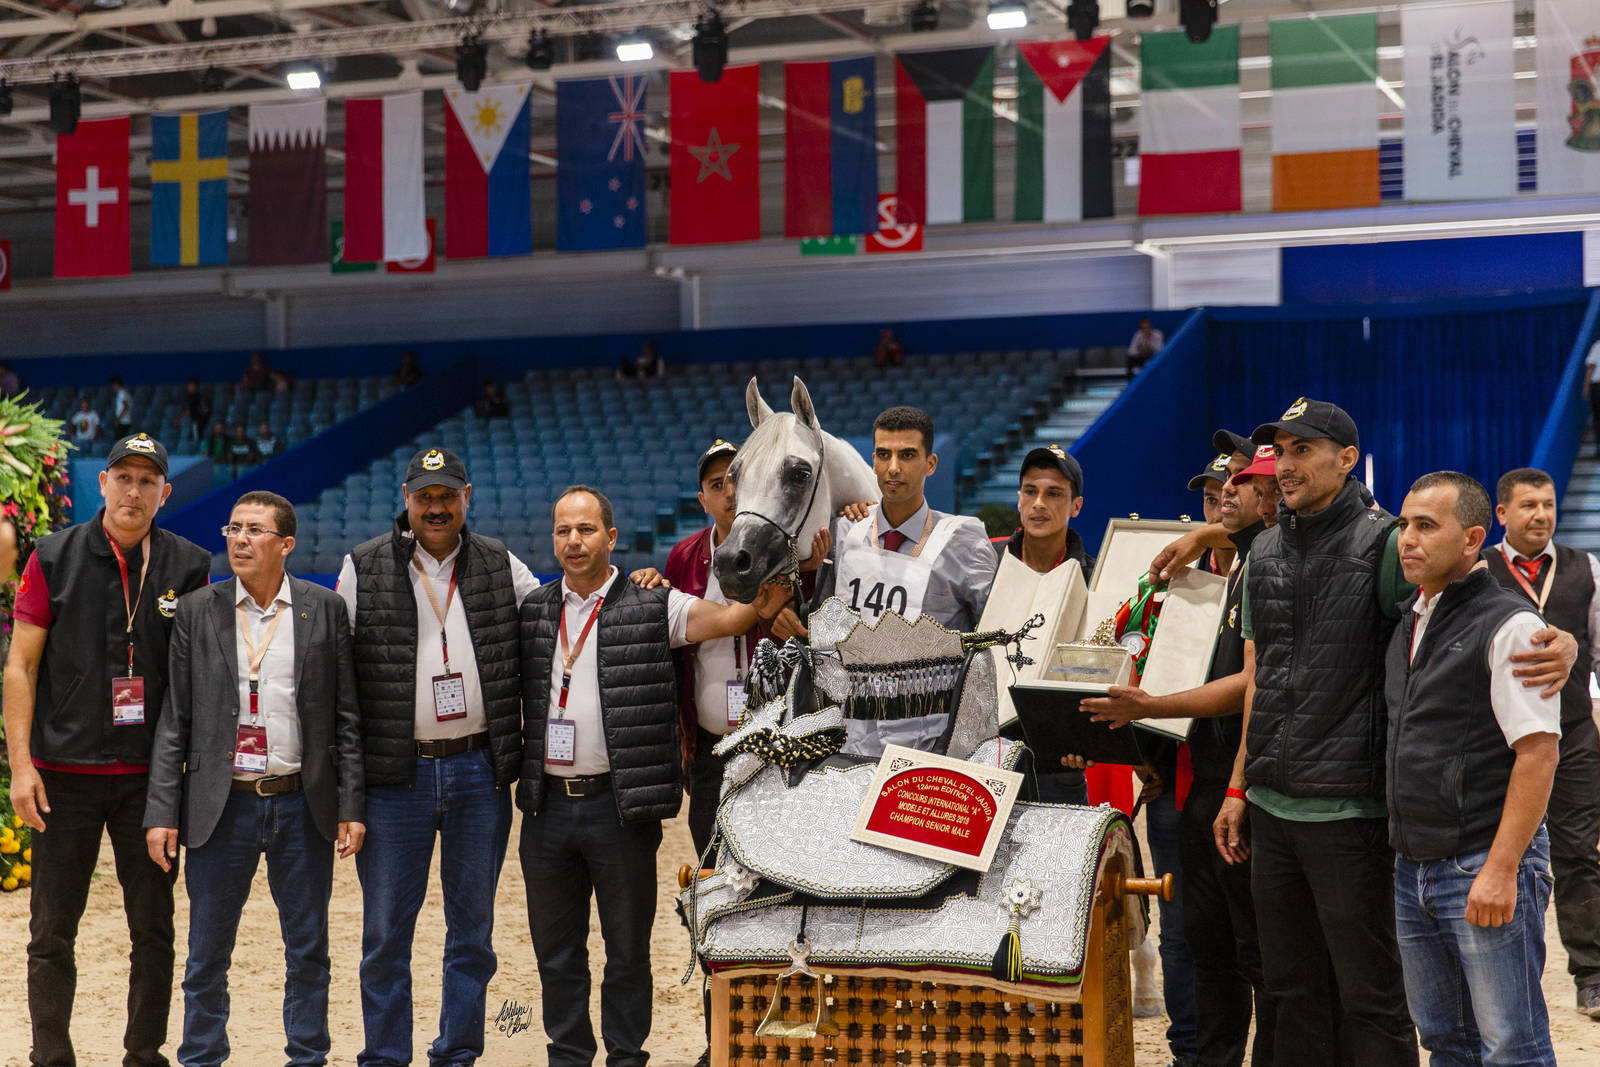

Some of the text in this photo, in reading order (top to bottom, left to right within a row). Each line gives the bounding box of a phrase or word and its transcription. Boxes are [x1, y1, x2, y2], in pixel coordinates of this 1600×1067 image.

[1448, 117, 1462, 179] CHEVAL
[848, 578, 907, 617] 140
[881, 778, 910, 797] SALON
[926, 775, 958, 788] CHEVAL
[959, 783, 975, 797] D'EL
[975, 795, 993, 822] JADIDA
[897, 789, 928, 804] CONCOURS
[928, 796, 970, 814] INTERNATIONAL
[941, 785, 969, 802] EDITION
[890, 811, 971, 838] CHAMPION SENIOR MALE
[898, 800, 922, 814] MODELE
[922, 806, 931, 816] ET
[929, 809, 956, 822] ALLURES
